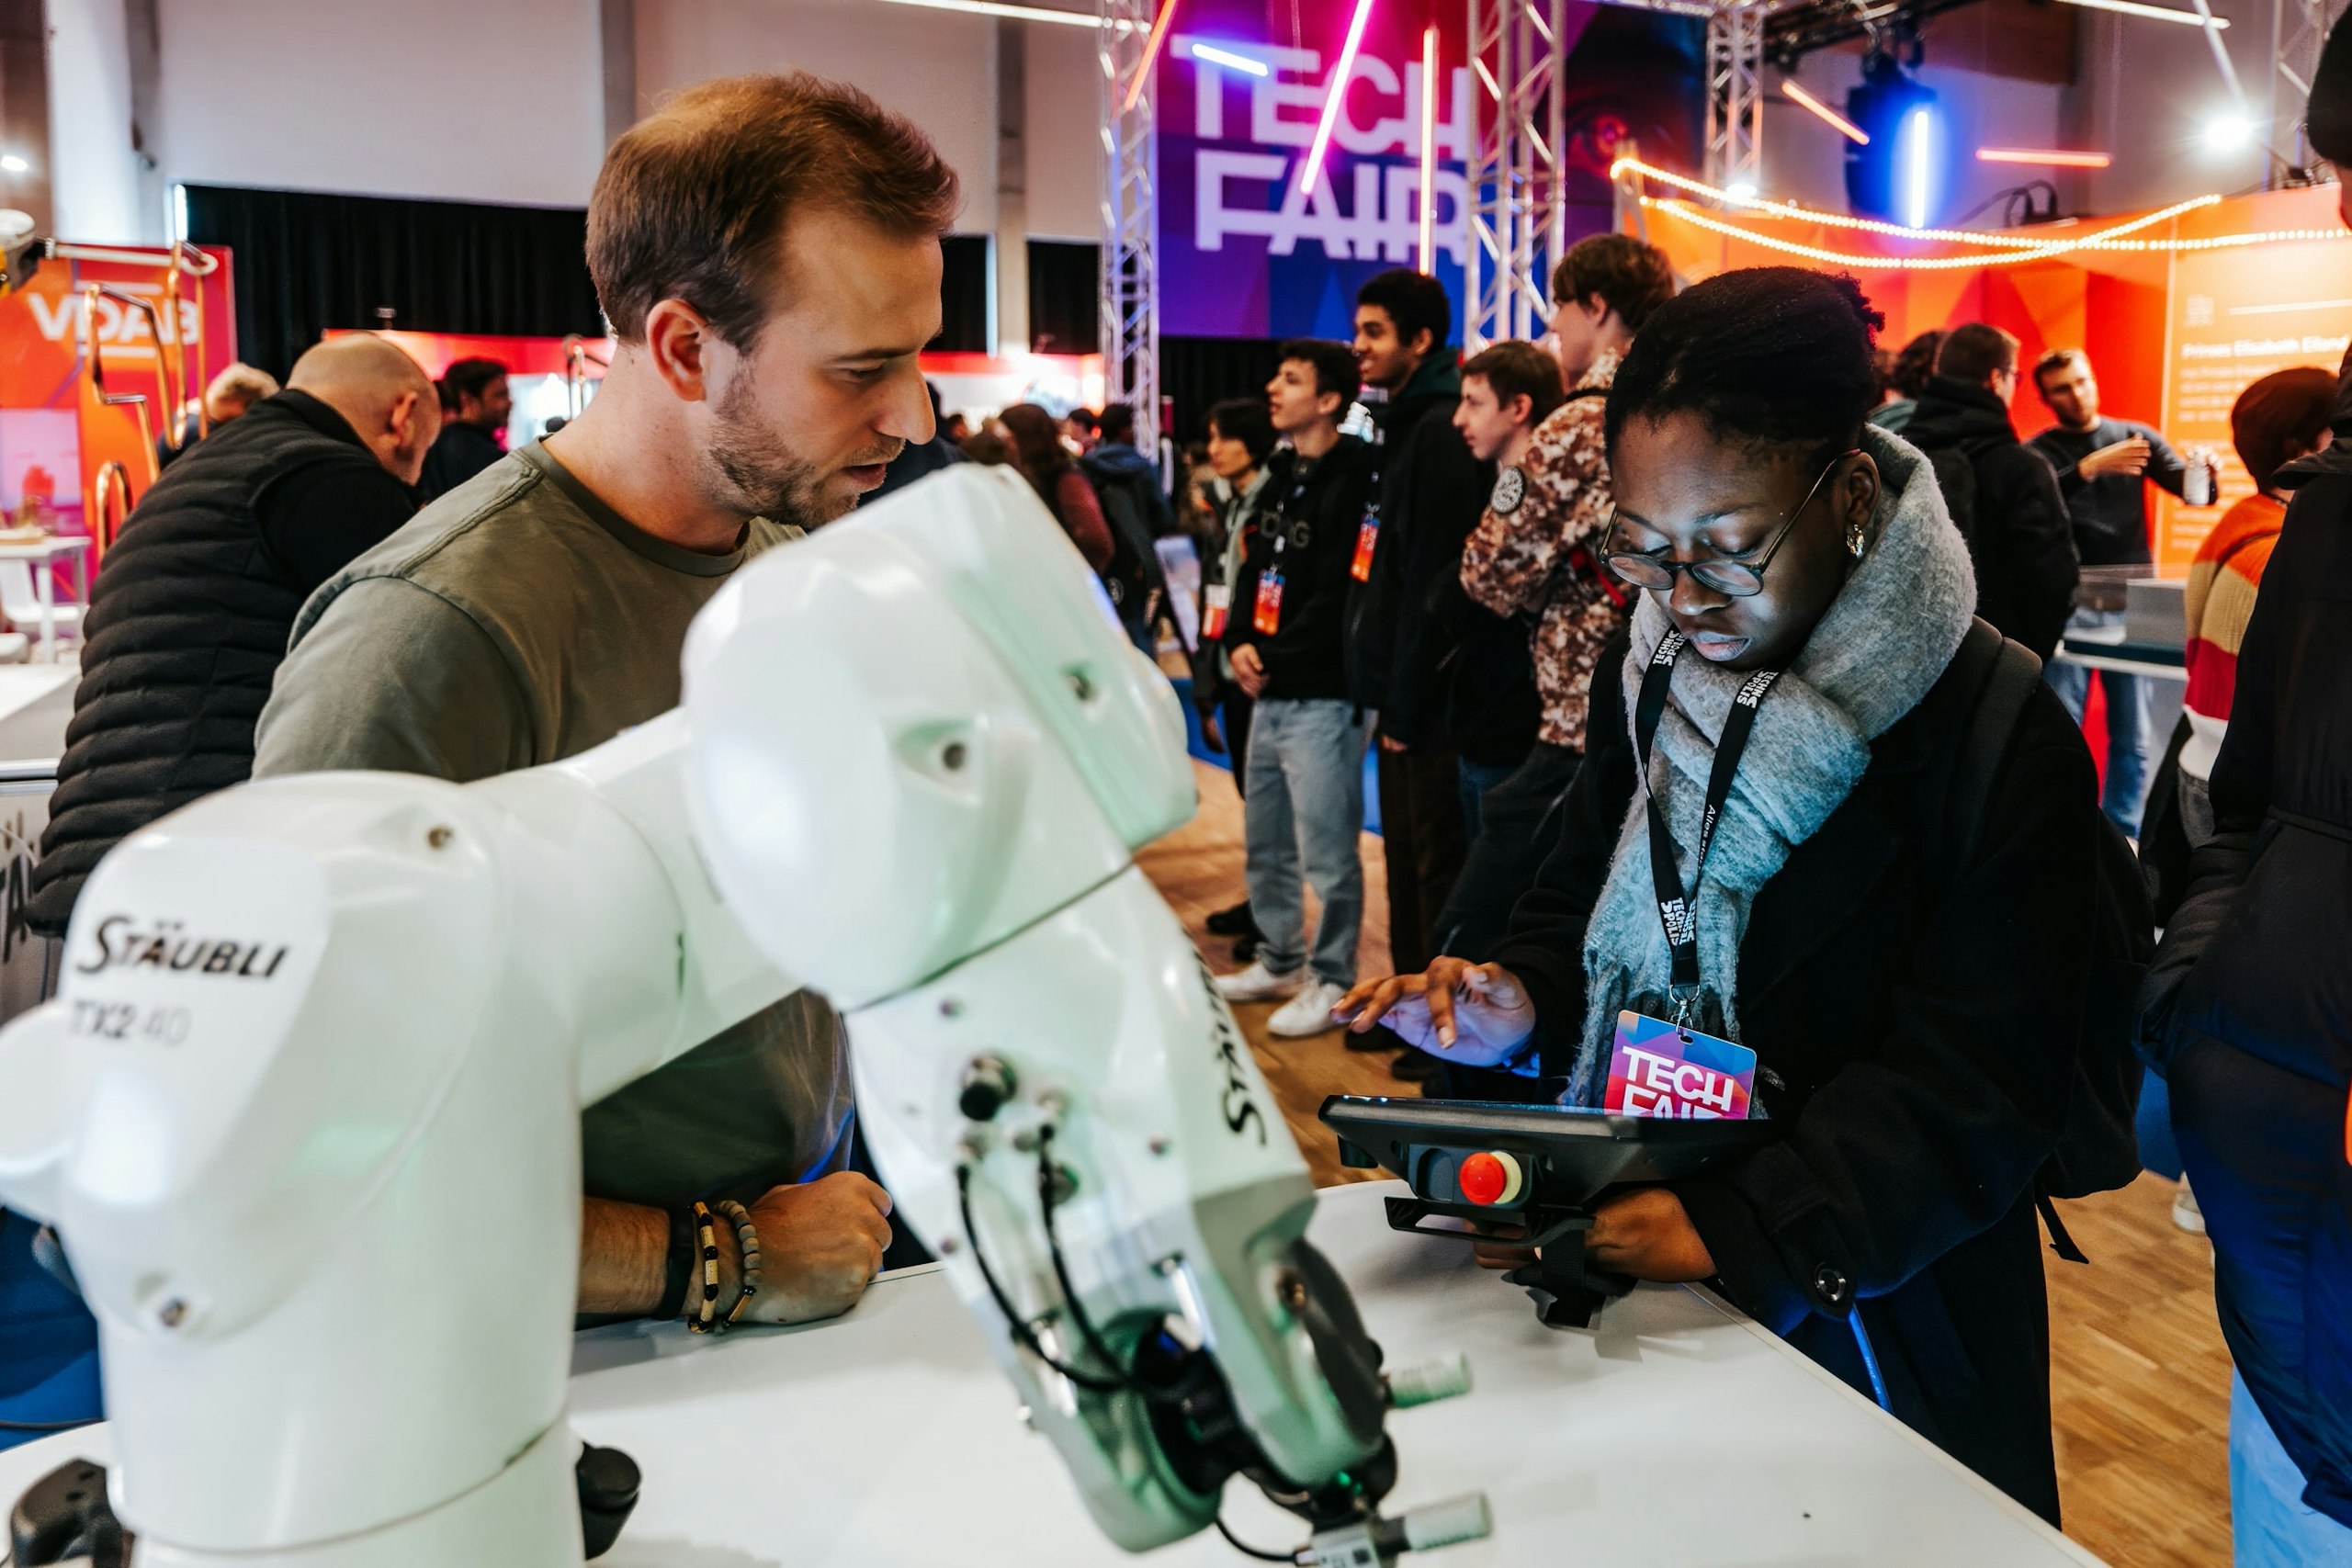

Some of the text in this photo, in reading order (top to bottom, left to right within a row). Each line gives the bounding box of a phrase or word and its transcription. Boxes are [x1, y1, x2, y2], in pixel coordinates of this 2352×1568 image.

[1170, 34, 1470, 159] TECH
[1196, 150, 1468, 265] FAIR
[28, 293, 199, 345] VDAB
[77, 915, 288, 978] STÄUBLI
[1623, 1046, 1734, 1111] TECH
